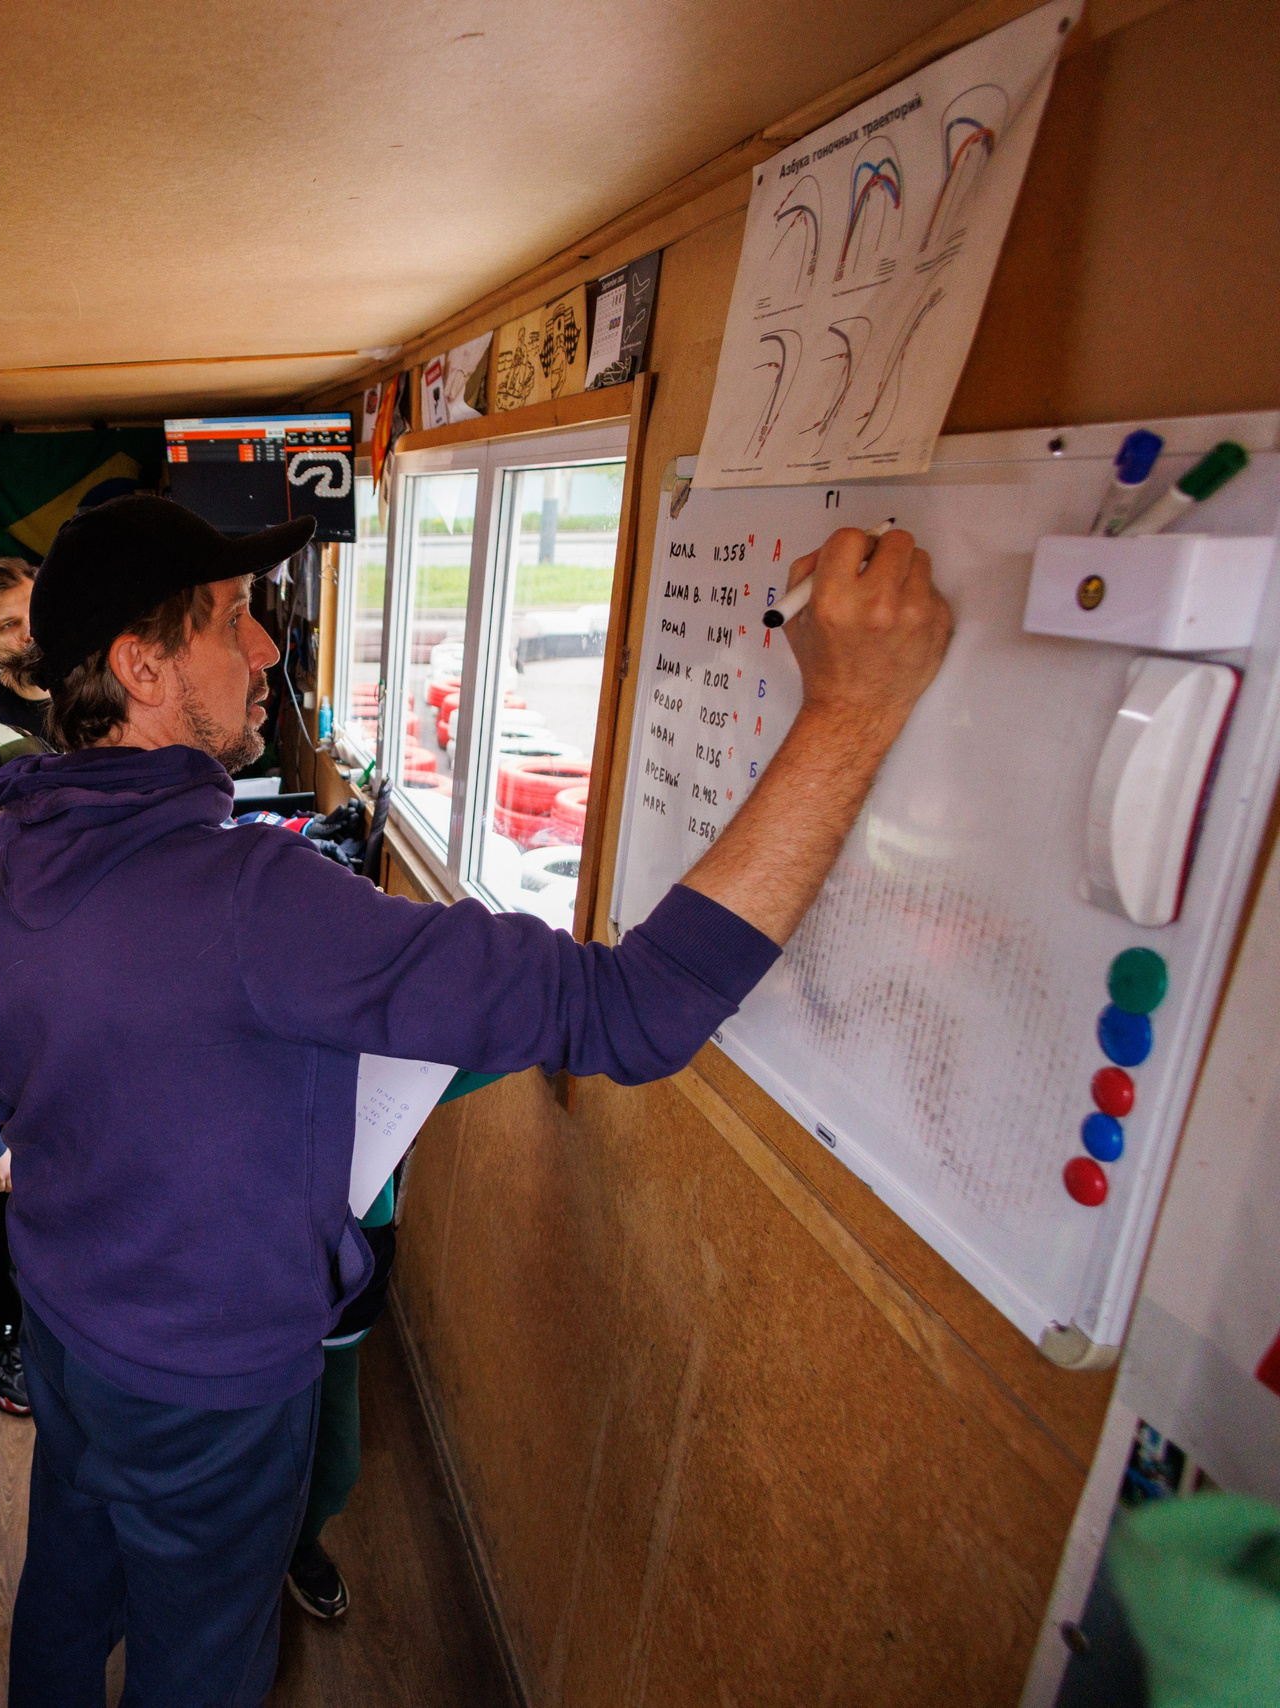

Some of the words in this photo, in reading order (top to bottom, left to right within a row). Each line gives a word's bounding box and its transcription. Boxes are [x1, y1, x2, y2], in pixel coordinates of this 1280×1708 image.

[779, 154, 811, 180] Азбука
[811, 128, 860, 163] гоночных
[861, 91, 923, 139] траекторий
[669, 541, 696, 559] КОЛЯ
[713, 543, 746, 562] 11.358
[772, 538, 782, 562] А
[664, 580, 689, 601] ДИМА
[711, 586, 738, 607] 11.761
[766, 586, 776, 607] Б
[661, 618, 686, 639] РОМА
[707, 625, 733, 649] 11.841
[656, 652, 680, 678] ДИМА
[703, 668, 729, 690] 12.012
[758, 679, 768, 699] Б
[699, 705, 729, 729] 12.035
[753, 715, 762, 737] А
[650, 722, 676, 748] ИВАН
[695, 742, 722, 769] 12.136
[749, 761, 759, 779] Б
[691, 783, 718, 806] 12.482
[642, 792, 667, 816] МАРК
[688, 815, 717, 843] 12.568
